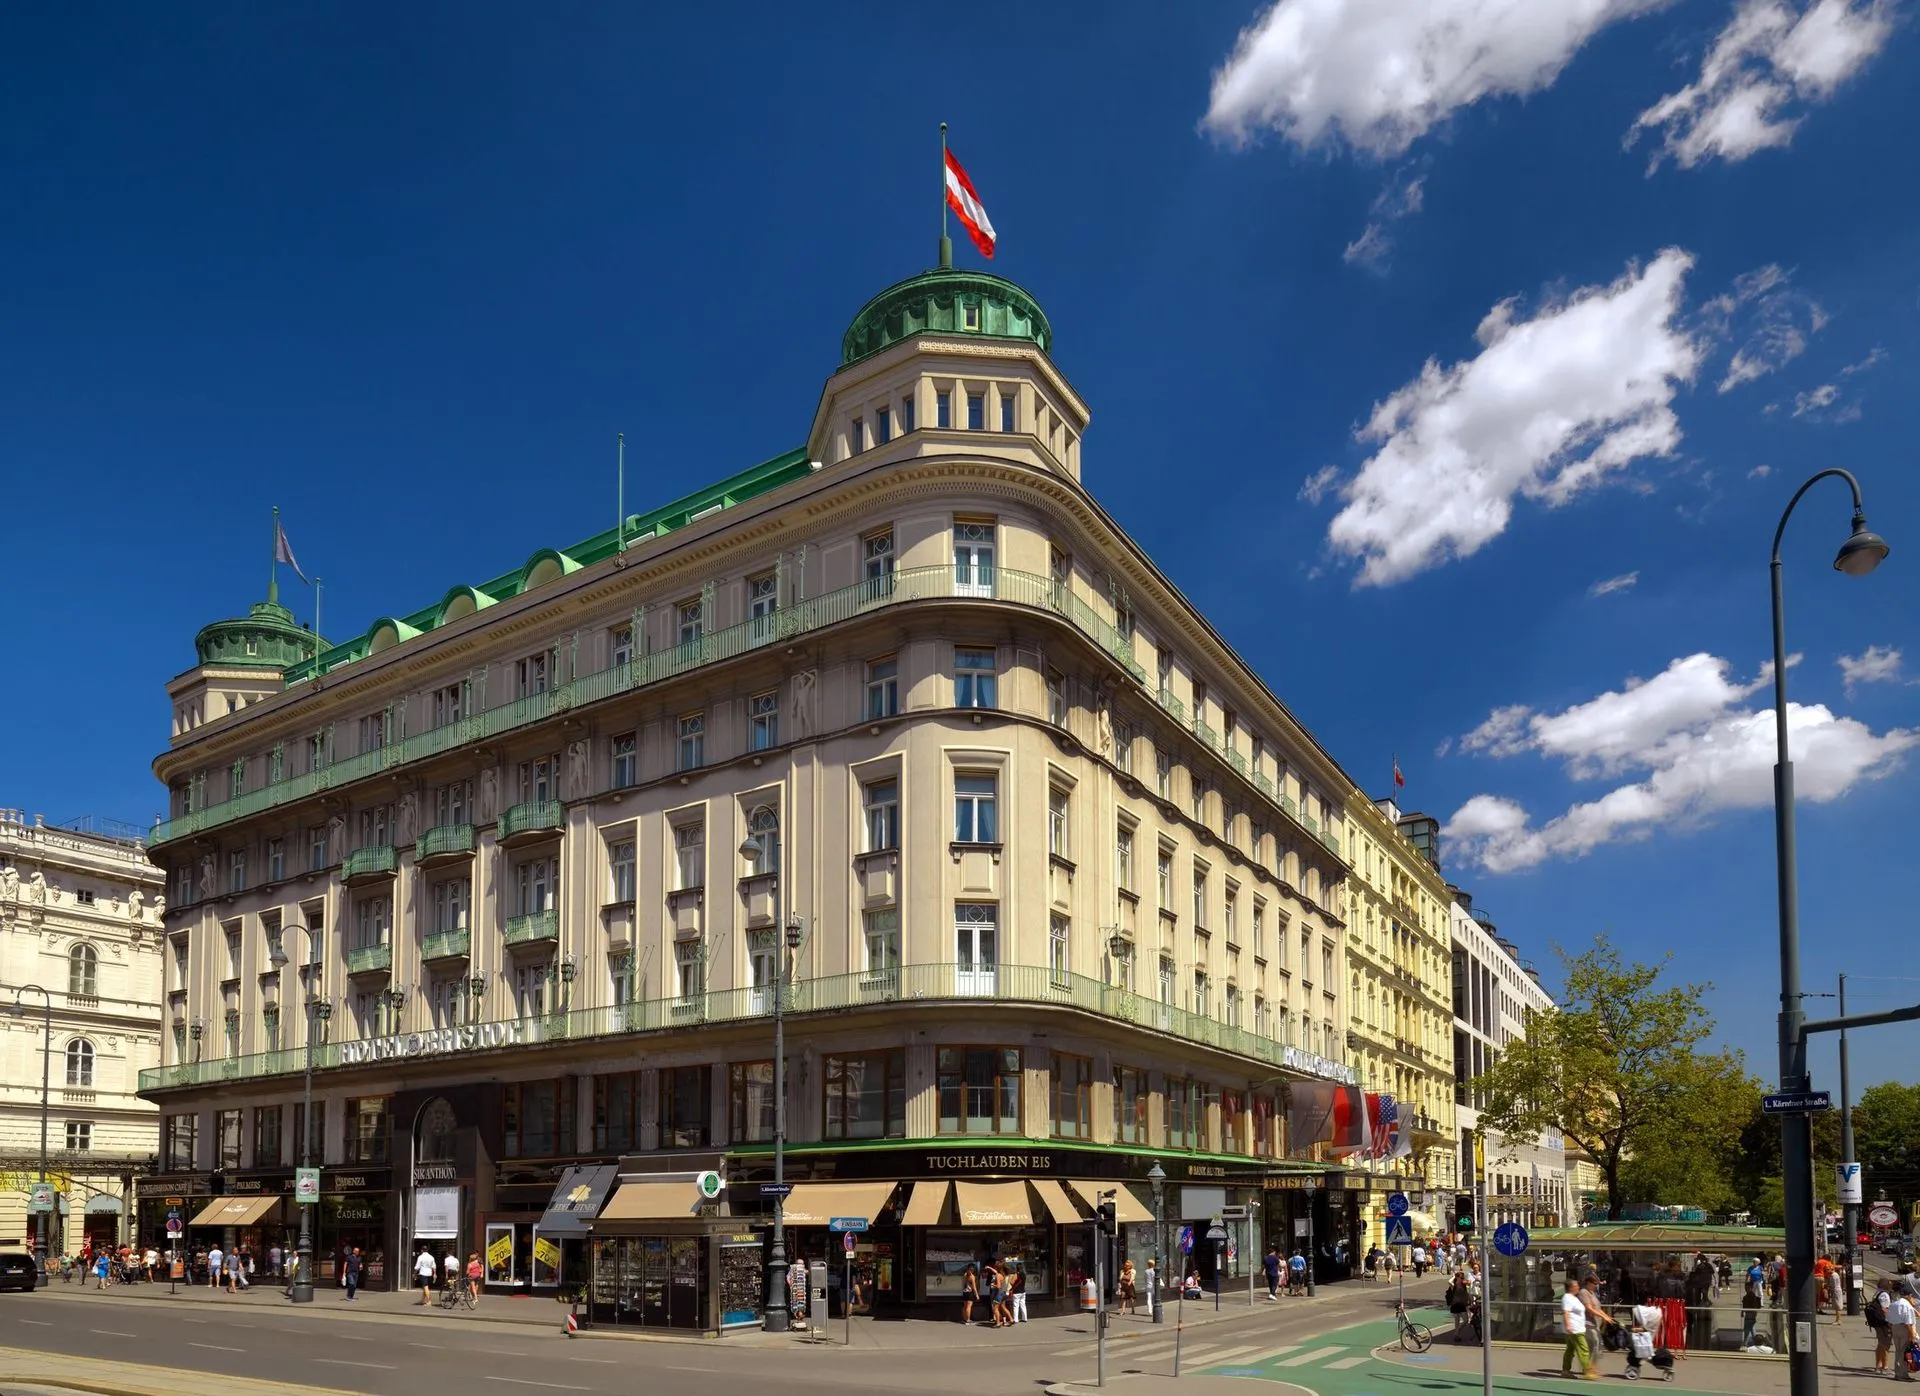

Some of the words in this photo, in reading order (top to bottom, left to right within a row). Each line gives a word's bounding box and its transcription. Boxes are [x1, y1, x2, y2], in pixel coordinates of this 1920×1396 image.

[926, 1155, 1028, 1169] TUCHLAUBEN
[1031, 1156, 1050, 1168] EIS
[426, 1167, 457, 1180] ANTHONY
[235, 1181, 261, 1190] PALMERS
[334, 1175, 366, 1187] CADENZA
[1267, 1177, 1323, 1188] BRISTL
[336, 1208, 373, 1219] CADENZA
[841, 1220, 863, 1229] EINBAHN
